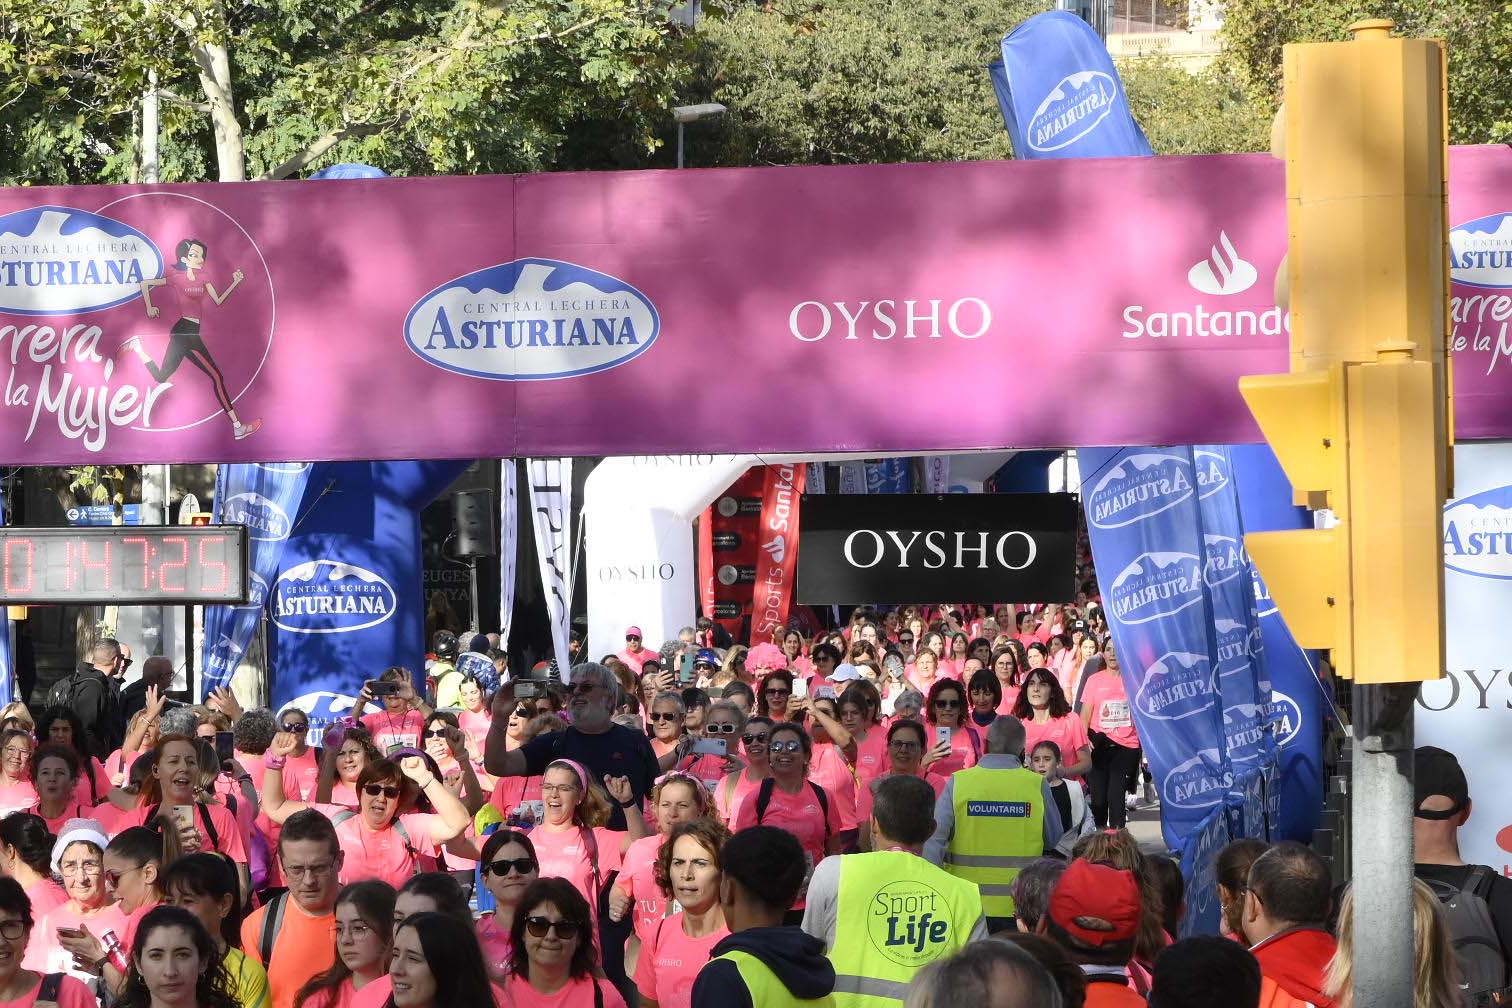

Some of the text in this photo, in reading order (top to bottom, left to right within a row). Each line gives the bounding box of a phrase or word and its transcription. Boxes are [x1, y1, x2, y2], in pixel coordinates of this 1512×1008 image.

[463, 299, 631, 314] CENTRAL LECHERA
[788, 297, 993, 343] OYSHO
[423, 305, 639, 350] ASTURIANA
[4, 367, 29, 407] la
[24, 359, 174, 452] Mujer
[843, 529, 1038, 570] OYSHO
[274, 589, 387, 617] ASTURIANA
[286, 584, 382, 594] CENTRAL LECHERA
[758, 567, 784, 633] Sports
[968, 804, 1025, 815] VOLUNTARIS
[640, 900, 656, 913] TU
[875, 891, 937, 918] Sport
[885, 913, 948, 953] Life
